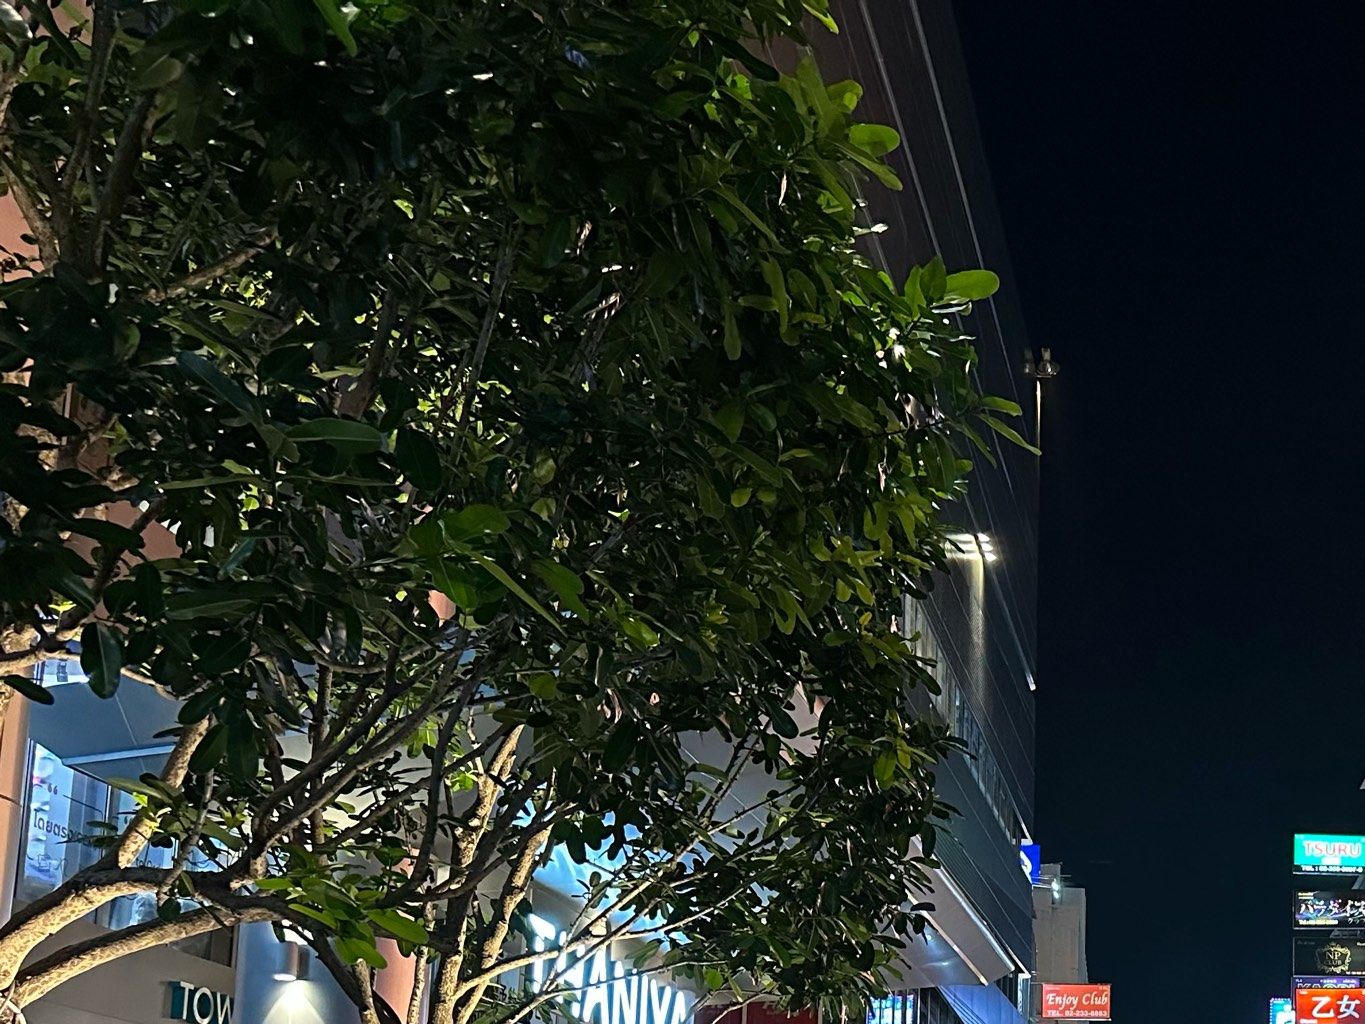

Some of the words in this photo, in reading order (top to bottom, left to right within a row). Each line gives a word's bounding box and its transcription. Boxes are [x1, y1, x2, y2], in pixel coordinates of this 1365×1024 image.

[1304, 842, 1361, 856] TSURU
[1325, 951, 1342, 960] NP
[1046, 992, 1079, 1010] Enjoy
[1082, 992, 1108, 1006] Club
[1311, 994, 1361, 1019] 乙女
